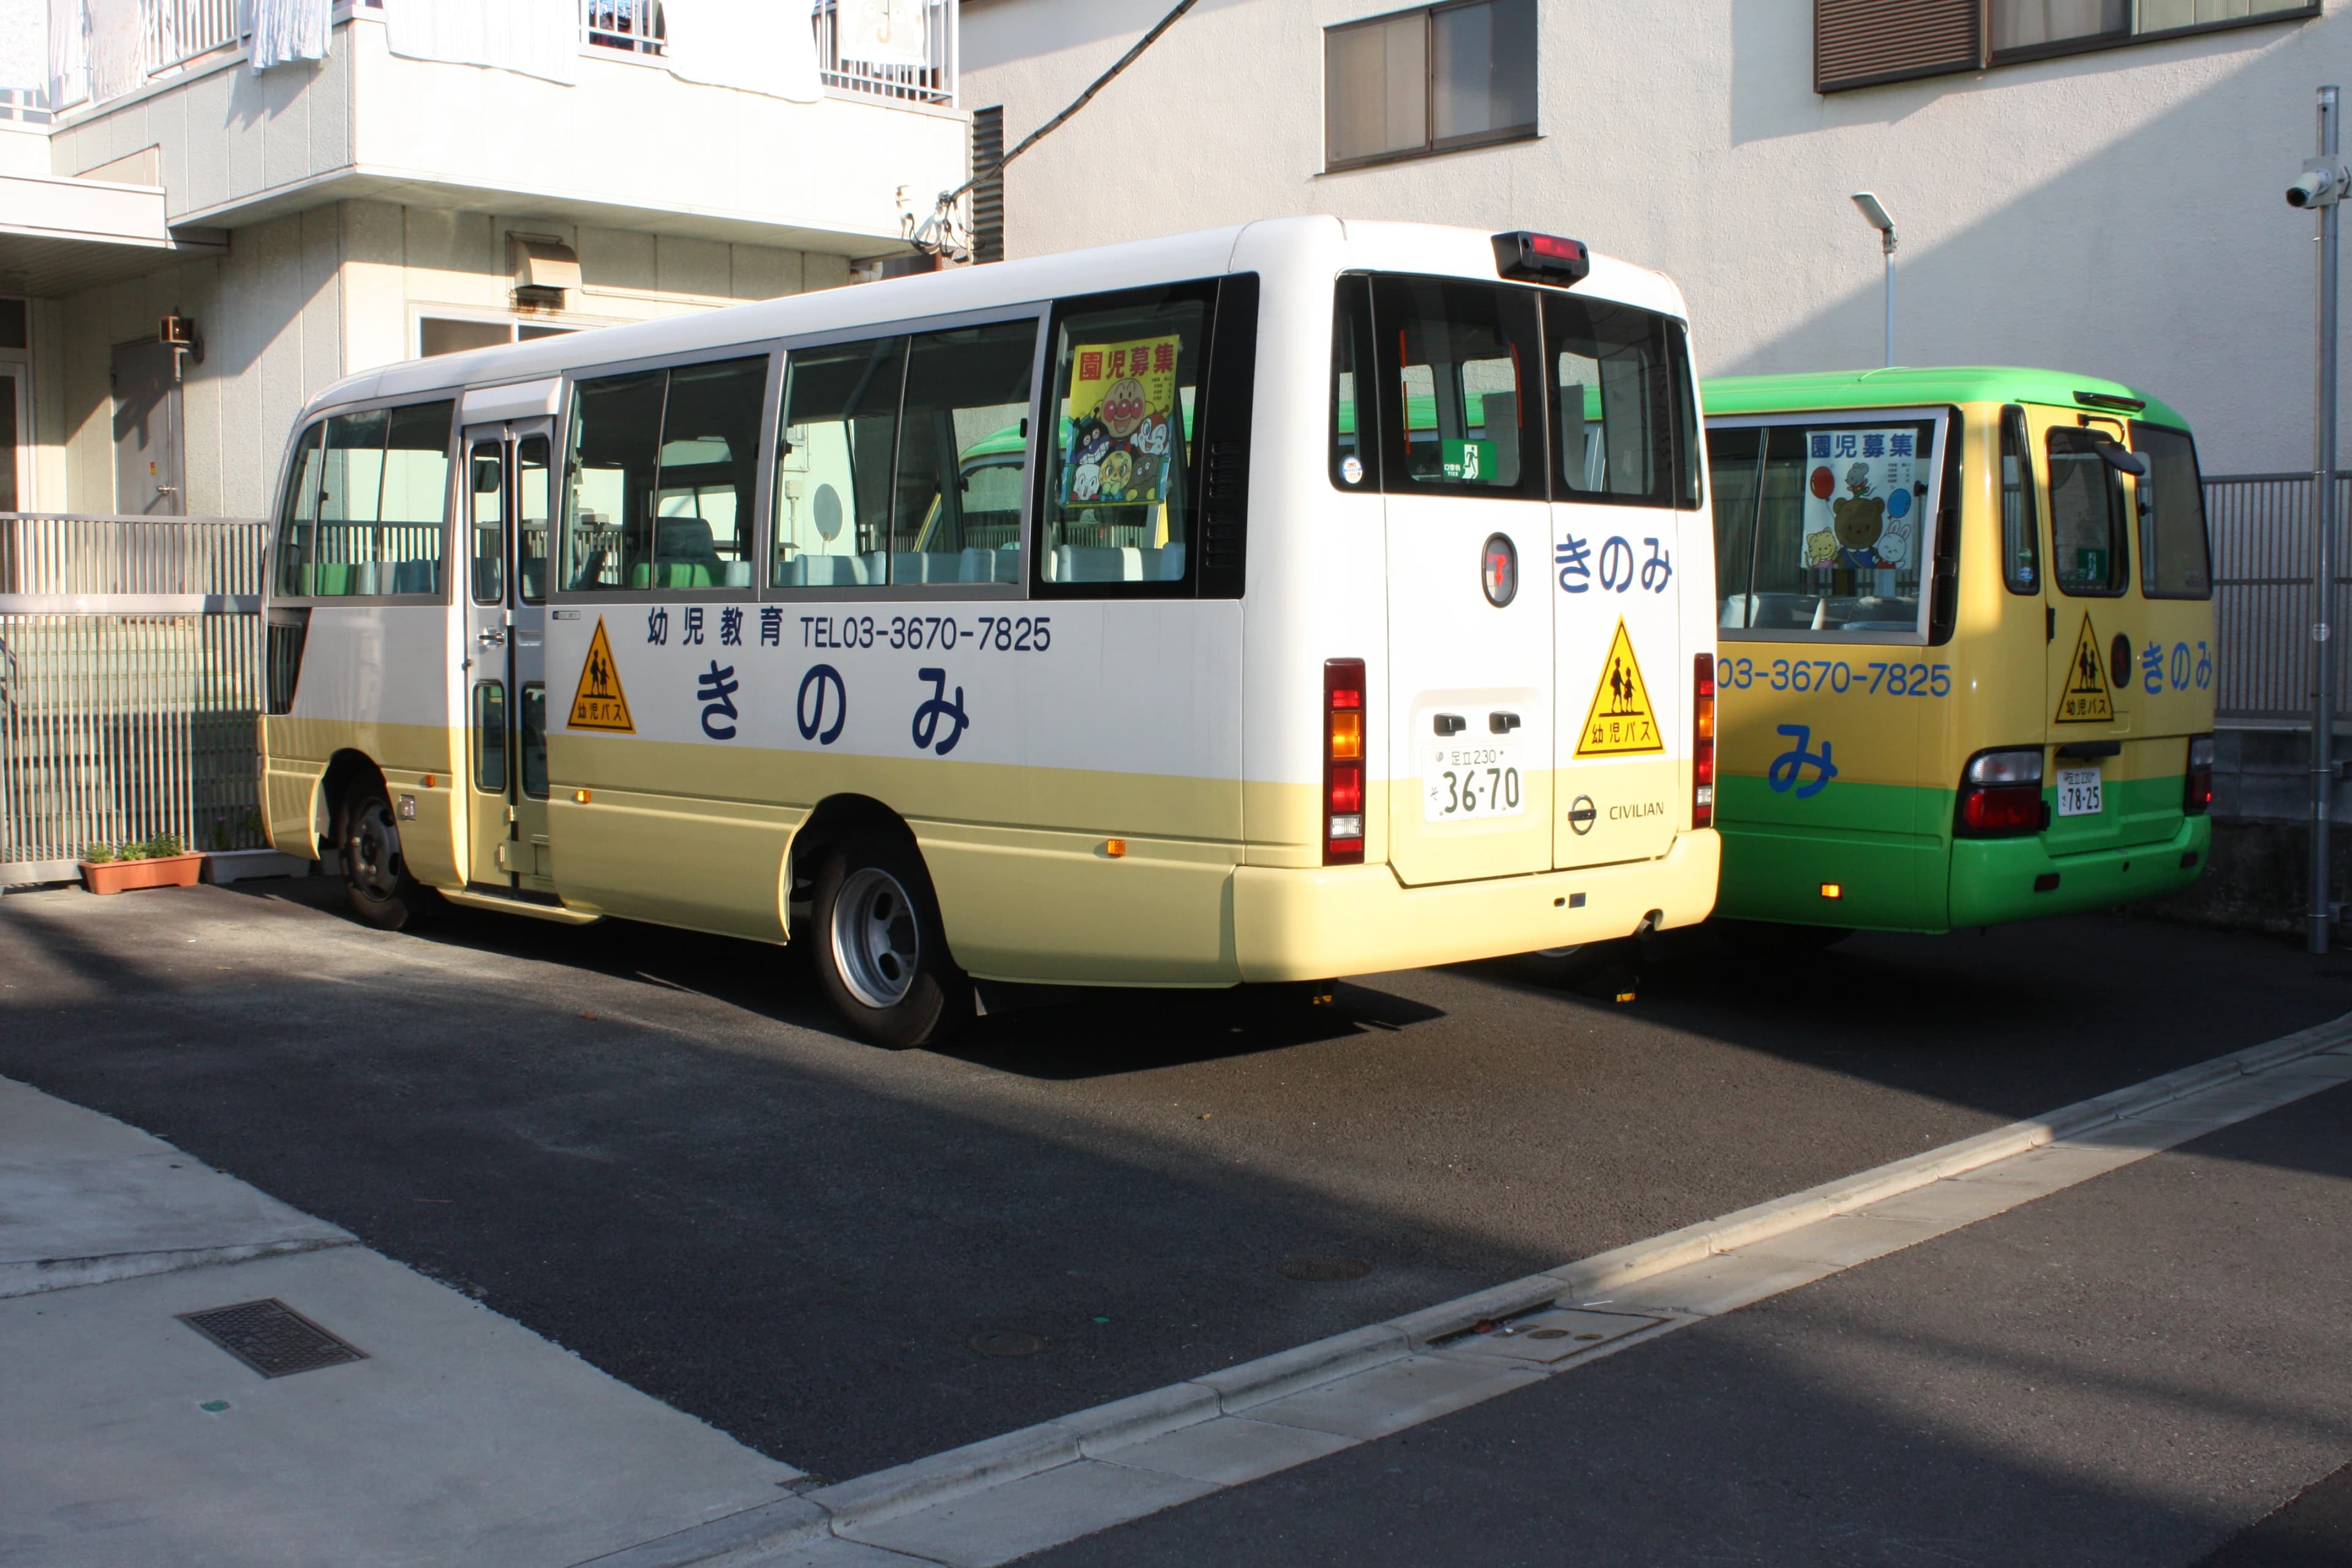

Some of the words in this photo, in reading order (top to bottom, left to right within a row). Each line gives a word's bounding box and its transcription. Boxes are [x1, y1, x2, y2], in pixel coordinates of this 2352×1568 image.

[1079, 343, 1174, 380] 園児募集
[1811, 433, 1913, 458] 園児募集
[1555, 533, 1672, 594] きのみ
[647, 606, 783, 647] 幼児教育
[801, 617, 1051, 651] TEL03-3670-7825
[1717, 658, 1950, 697] 03-3670-7825
[2142, 640, 2212, 695] きのみ
[578, 702, 622, 721] 幼児バス
[696, 659, 969, 755] きのみ
[2066, 699, 2106, 715] 幼児バス
[1591, 721, 1651, 744] 幼児バス
[1609, 802, 1664, 820] CIVILIAN
